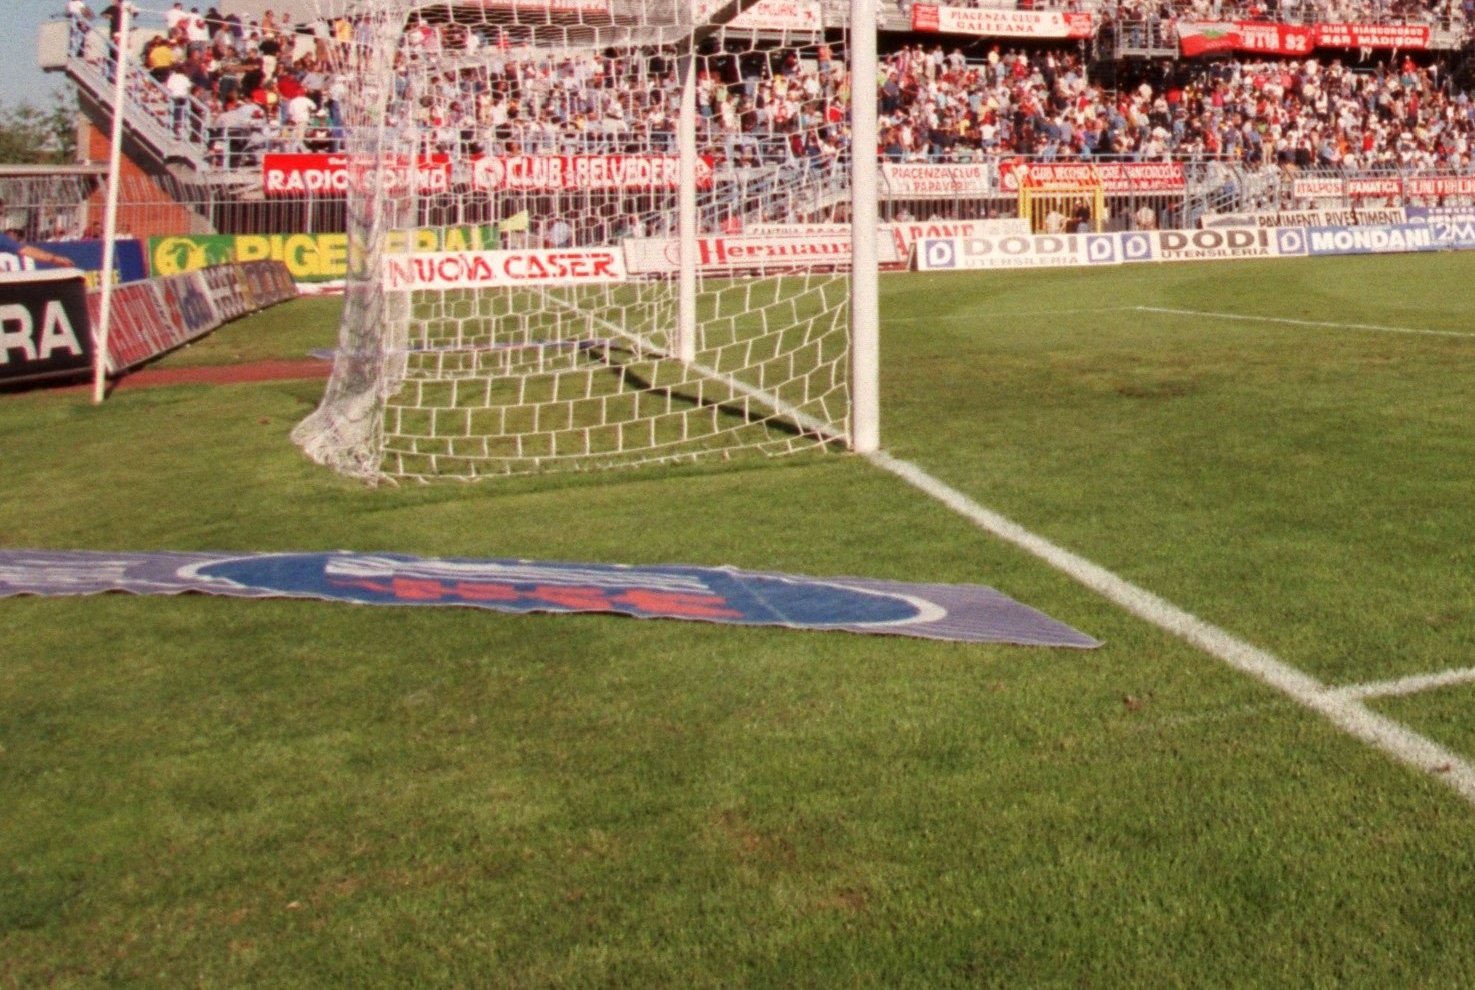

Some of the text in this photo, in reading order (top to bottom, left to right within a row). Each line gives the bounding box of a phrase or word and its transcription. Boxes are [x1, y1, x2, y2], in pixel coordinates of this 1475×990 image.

[1011, 13, 1041, 23] CLUB
[267, 169, 349, 191] RADIO
[506, 157, 682, 187] CLUB BELVEDER
[963, 235, 1078, 256] DODI
[1159, 228, 1269, 250] DODI
[1311, 227, 1430, 251] MONDANI
[1162, 247, 1270, 259] UTENSILERIA
[389, 252, 619, 287] NUOVA CASER
